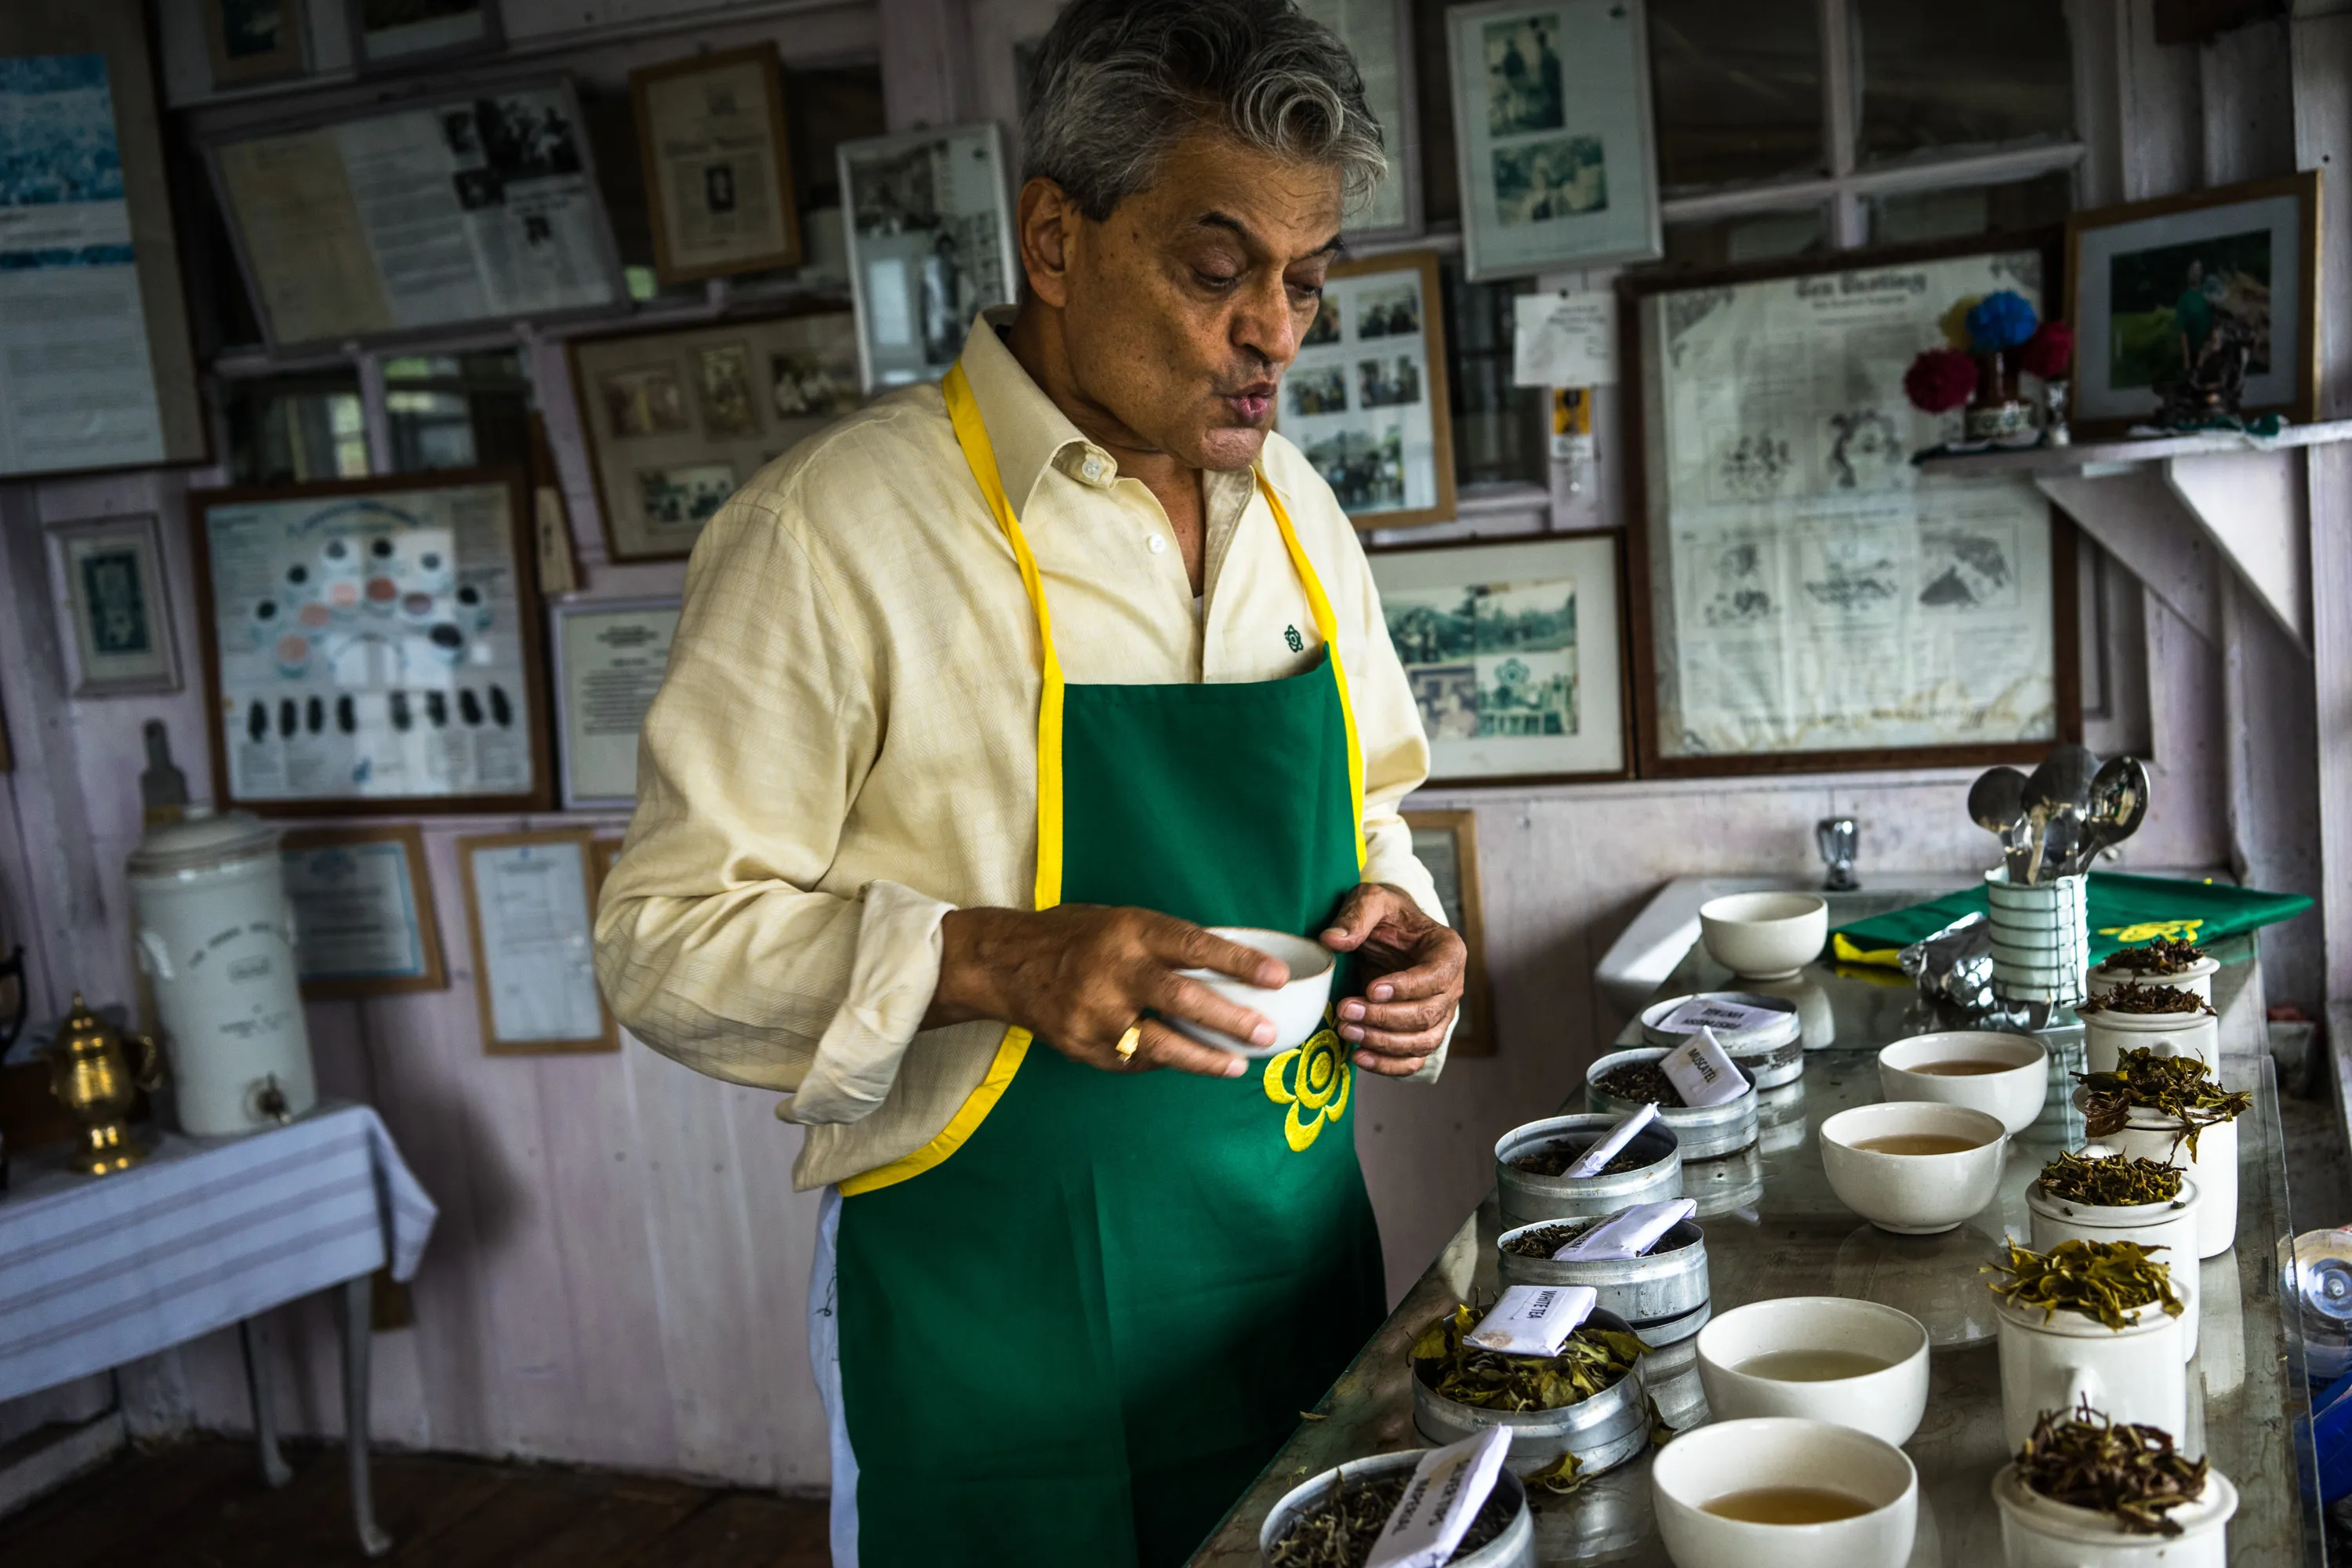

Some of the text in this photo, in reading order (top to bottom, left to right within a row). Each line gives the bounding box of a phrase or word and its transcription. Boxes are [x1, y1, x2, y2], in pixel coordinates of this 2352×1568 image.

[1687, 1048, 1716, 1083] MUSCATEL
[1526, 1290, 1557, 1319] WHITE TEA
